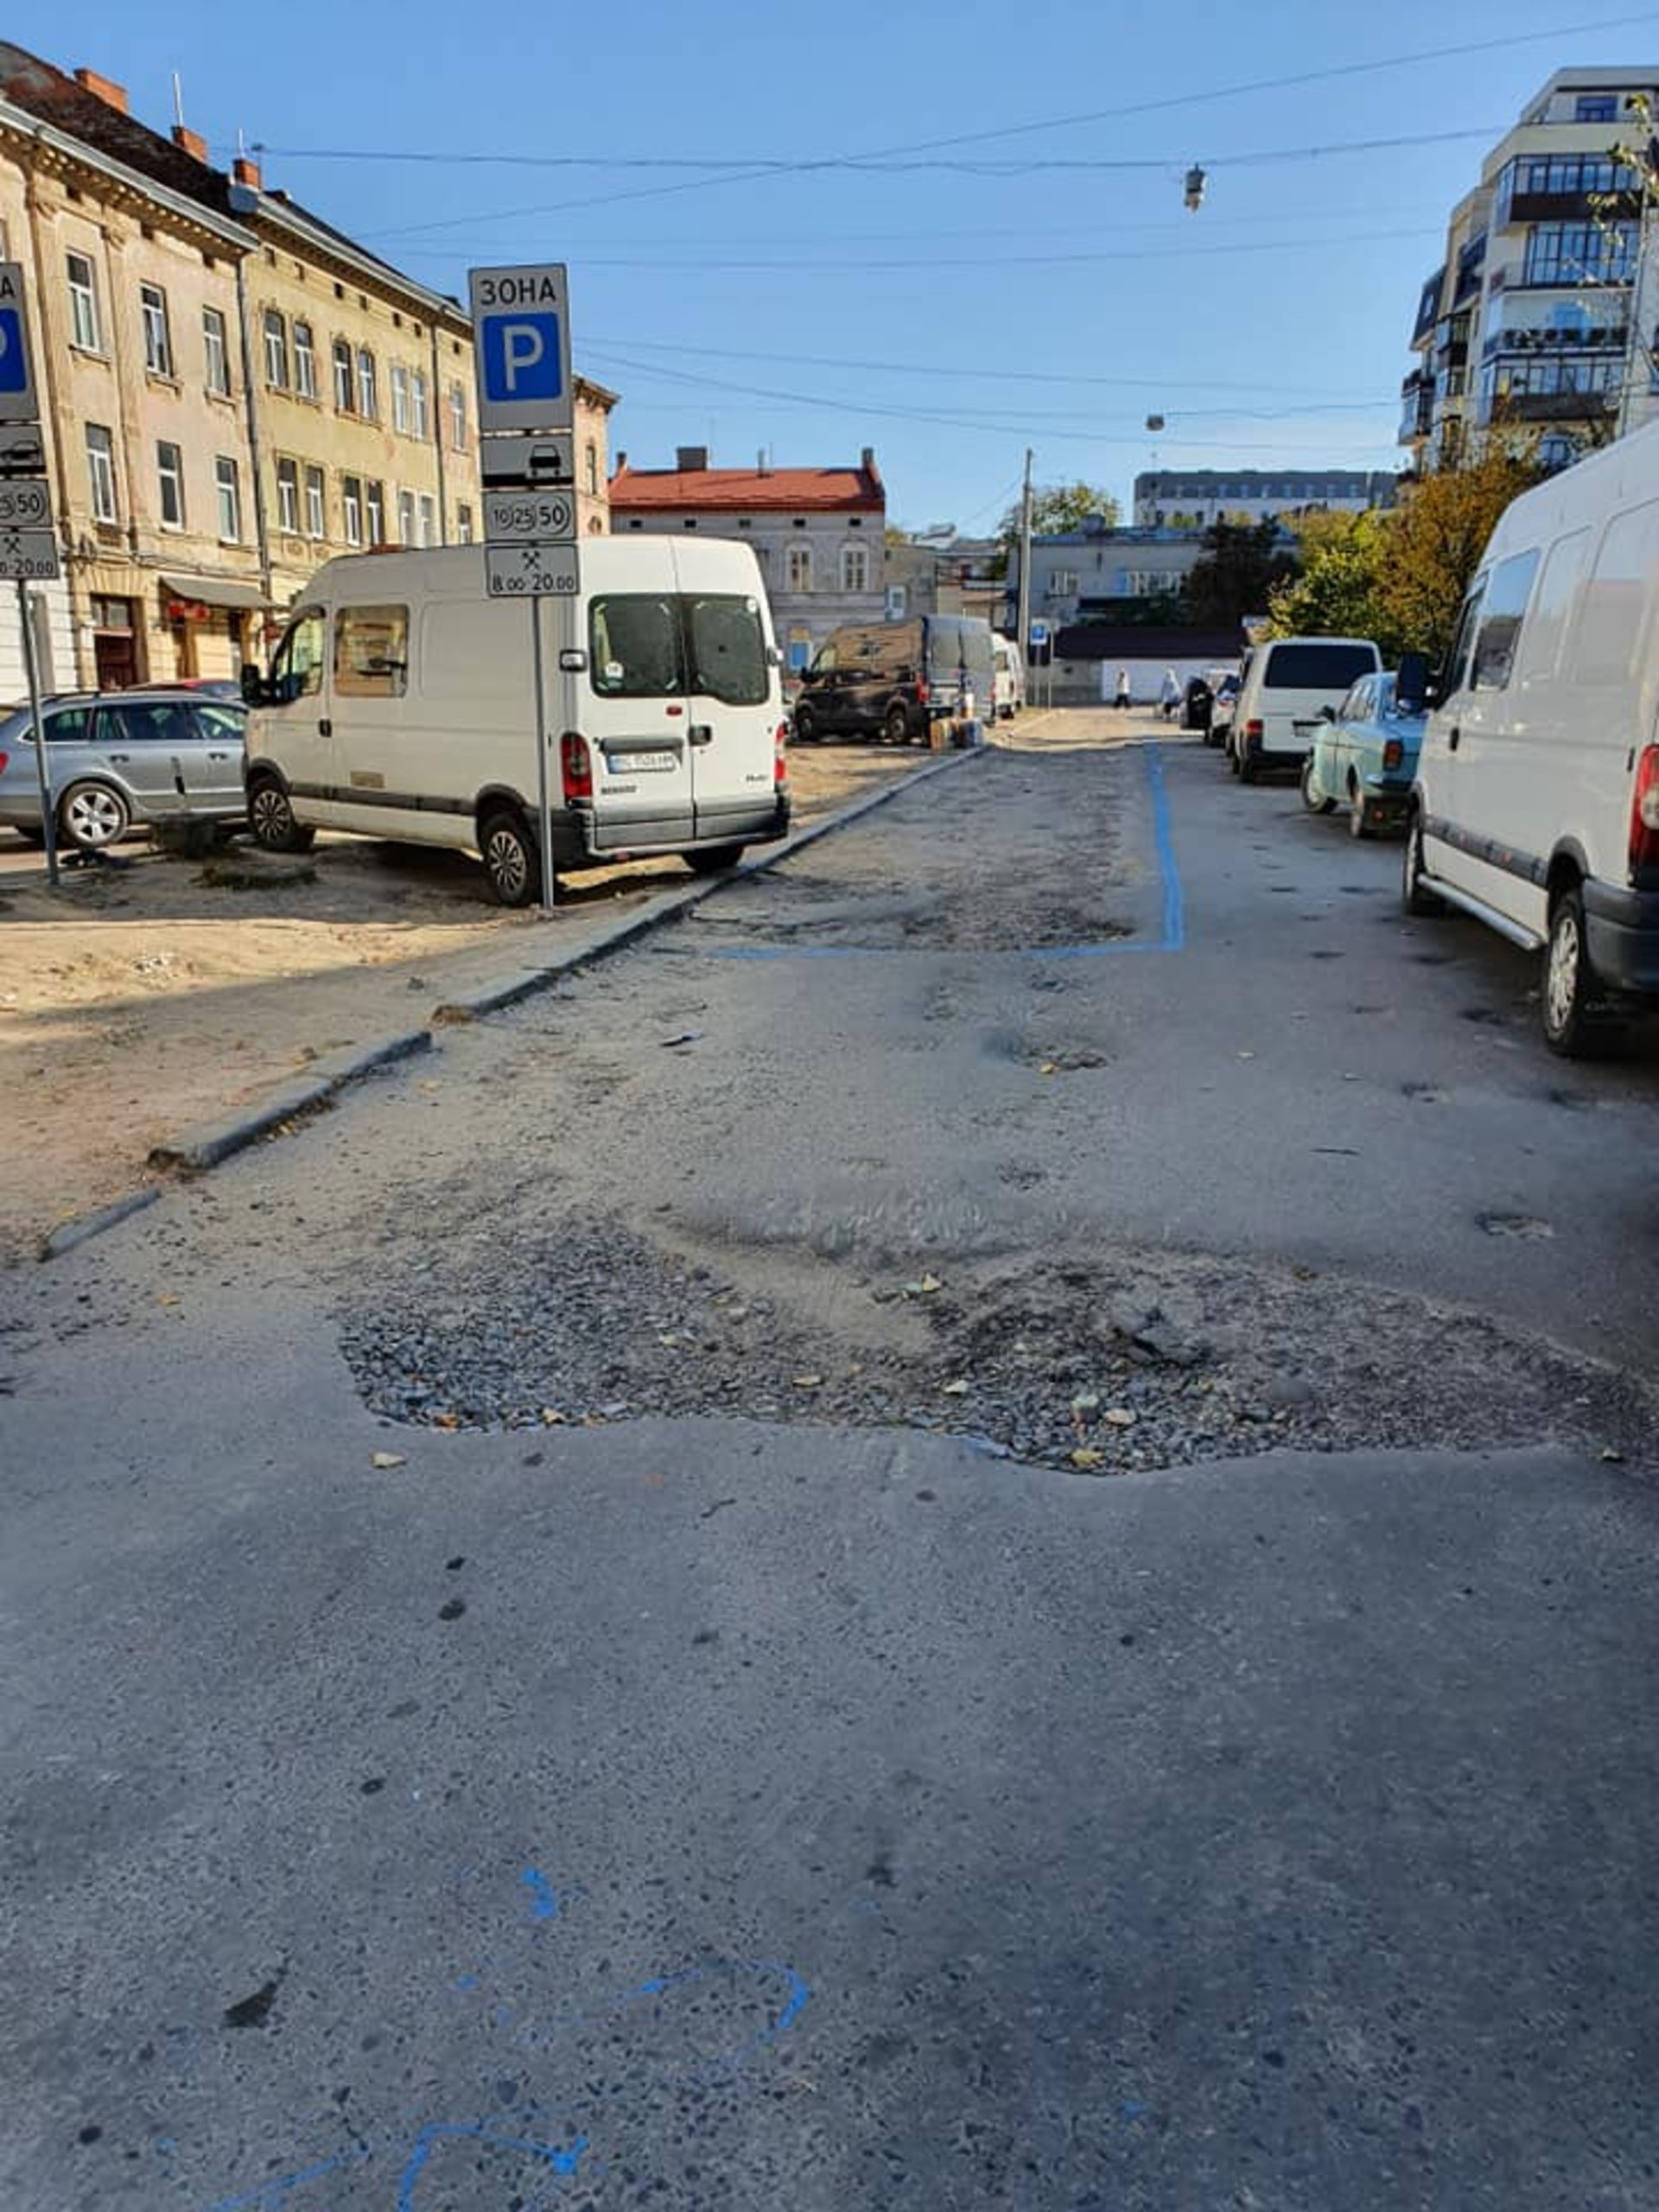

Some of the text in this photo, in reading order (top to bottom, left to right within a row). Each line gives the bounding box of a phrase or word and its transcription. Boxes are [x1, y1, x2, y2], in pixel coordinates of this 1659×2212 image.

[480, 276, 556, 305] ЗОНА
[17, 493, 40, 513] 50
[539, 505, 564, 526] 50
